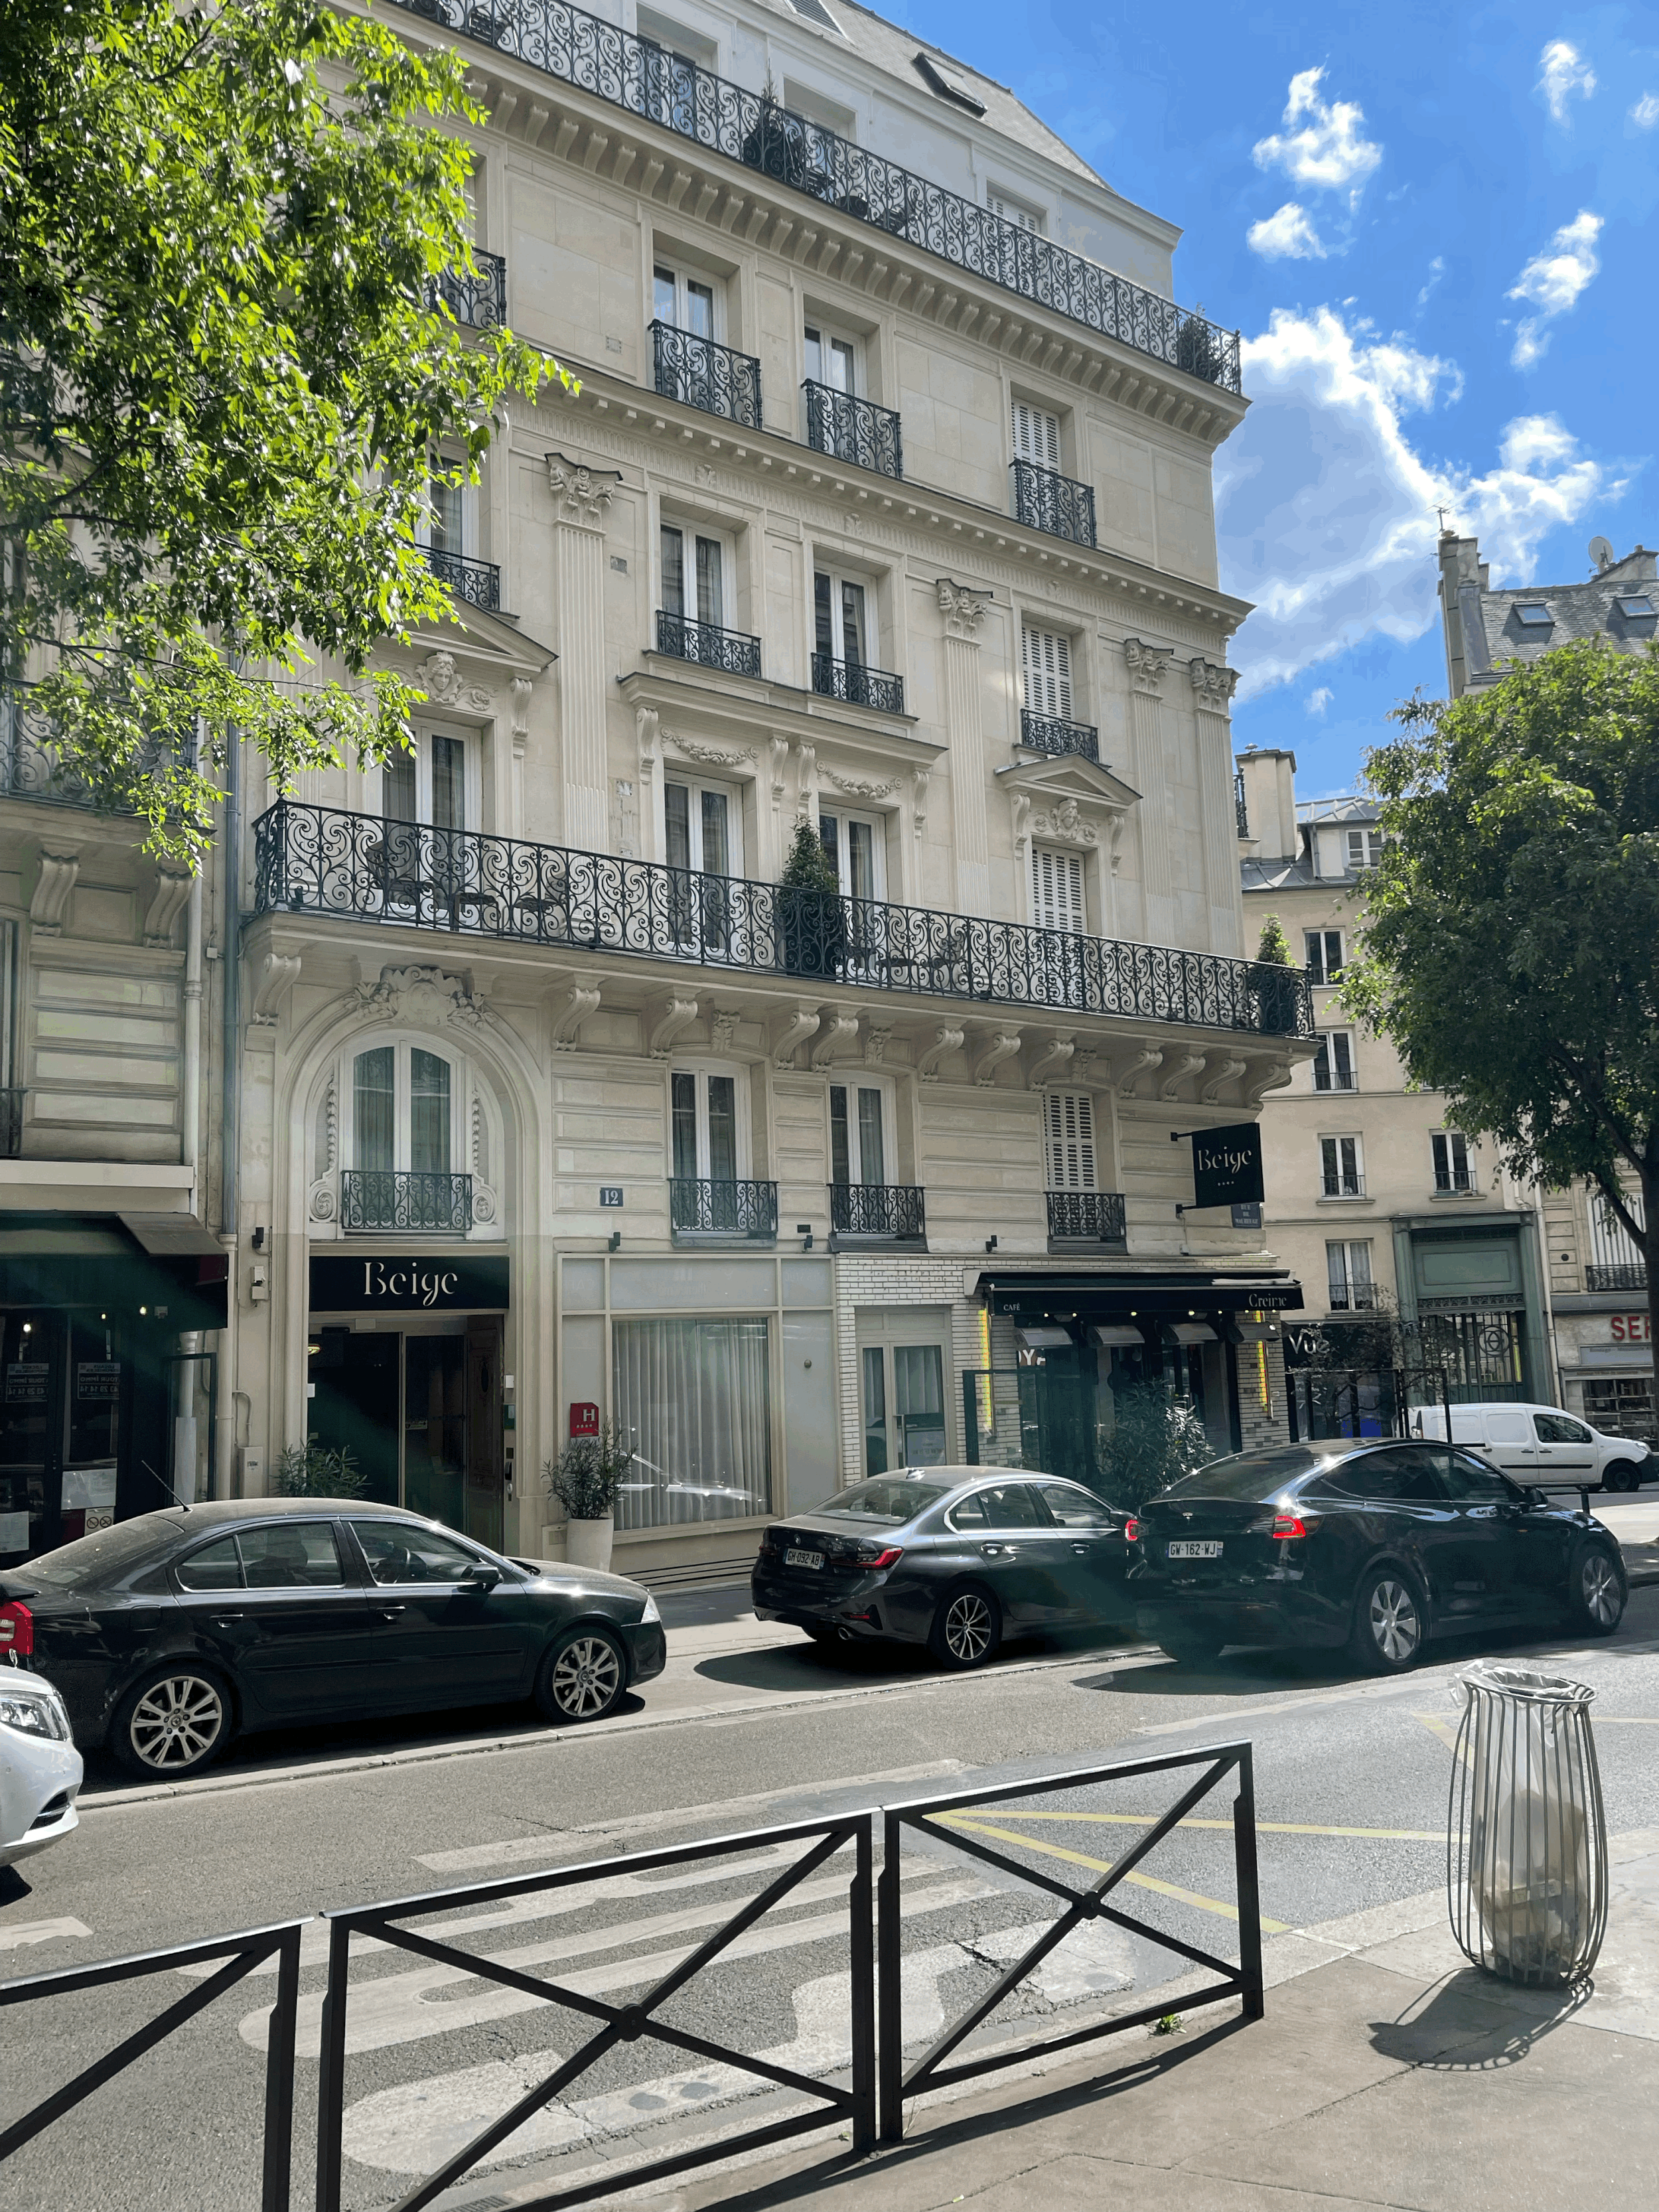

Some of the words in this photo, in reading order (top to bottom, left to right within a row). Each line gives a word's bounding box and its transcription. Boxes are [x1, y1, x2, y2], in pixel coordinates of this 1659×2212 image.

[1198, 1146, 1252, 1174] Beige
[605, 1190, 618, 1205] 12
[364, 1262, 458, 1307] Beige
[1003, 1302, 1021, 1311] CAFÉ
[583, 1408, 595, 1422] H
[1170, 1543, 1216, 1556] GW-162-WJ
